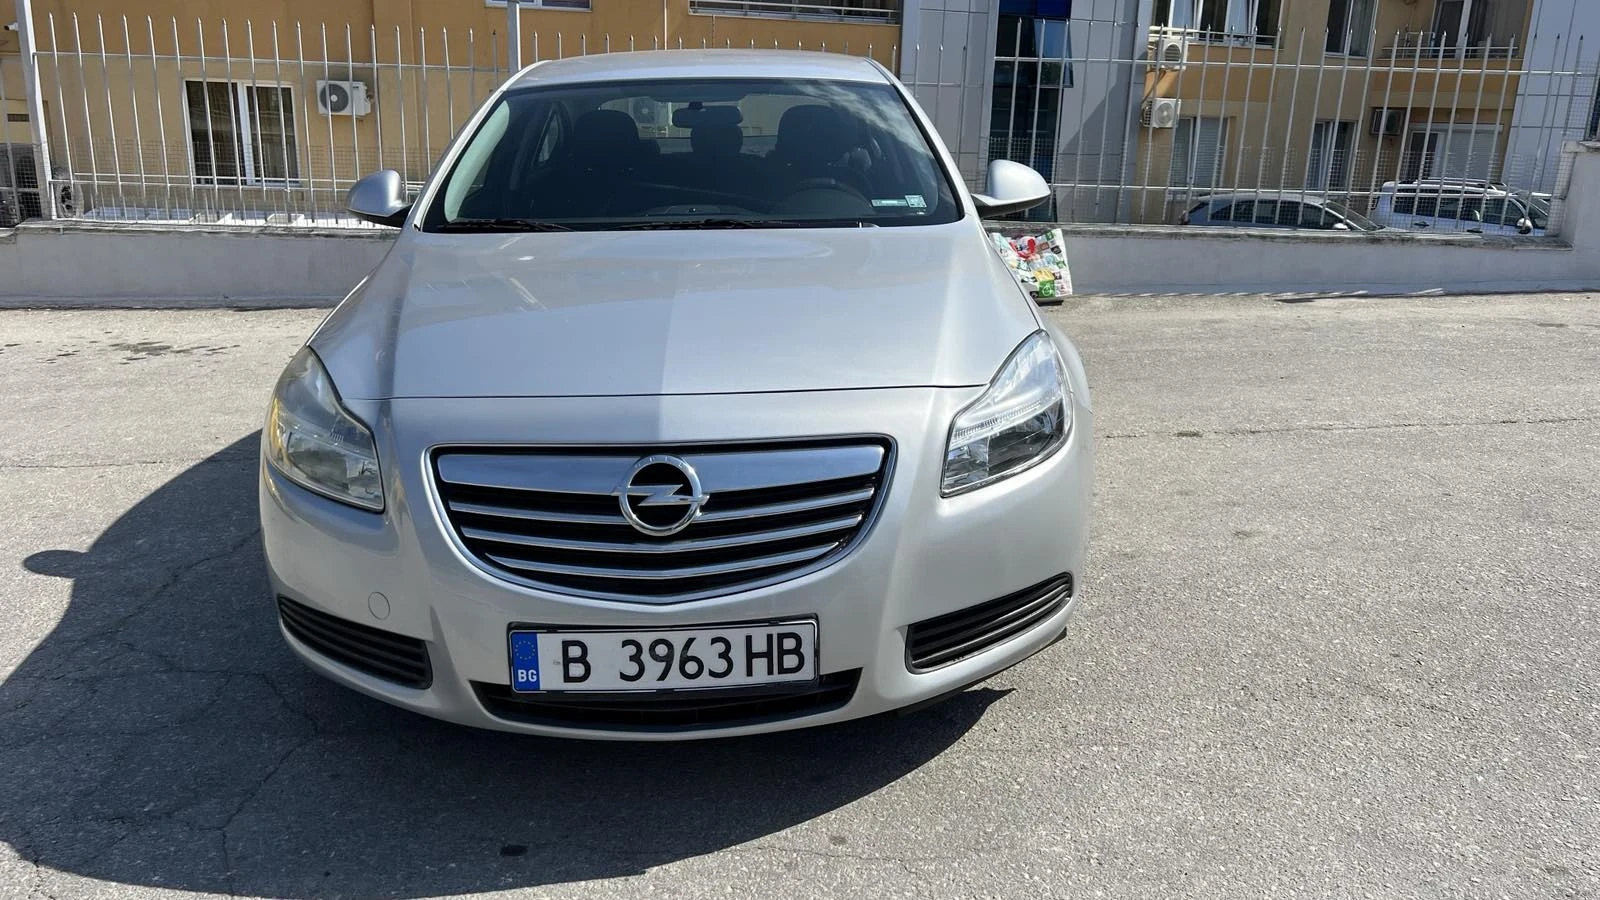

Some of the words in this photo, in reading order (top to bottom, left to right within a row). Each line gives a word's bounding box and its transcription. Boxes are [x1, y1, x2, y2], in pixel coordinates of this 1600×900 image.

[562, 640, 592, 683] B
[619, 637, 734, 682] 3963
[745, 631, 805, 677] HB
[517, 669, 538, 683] BG
